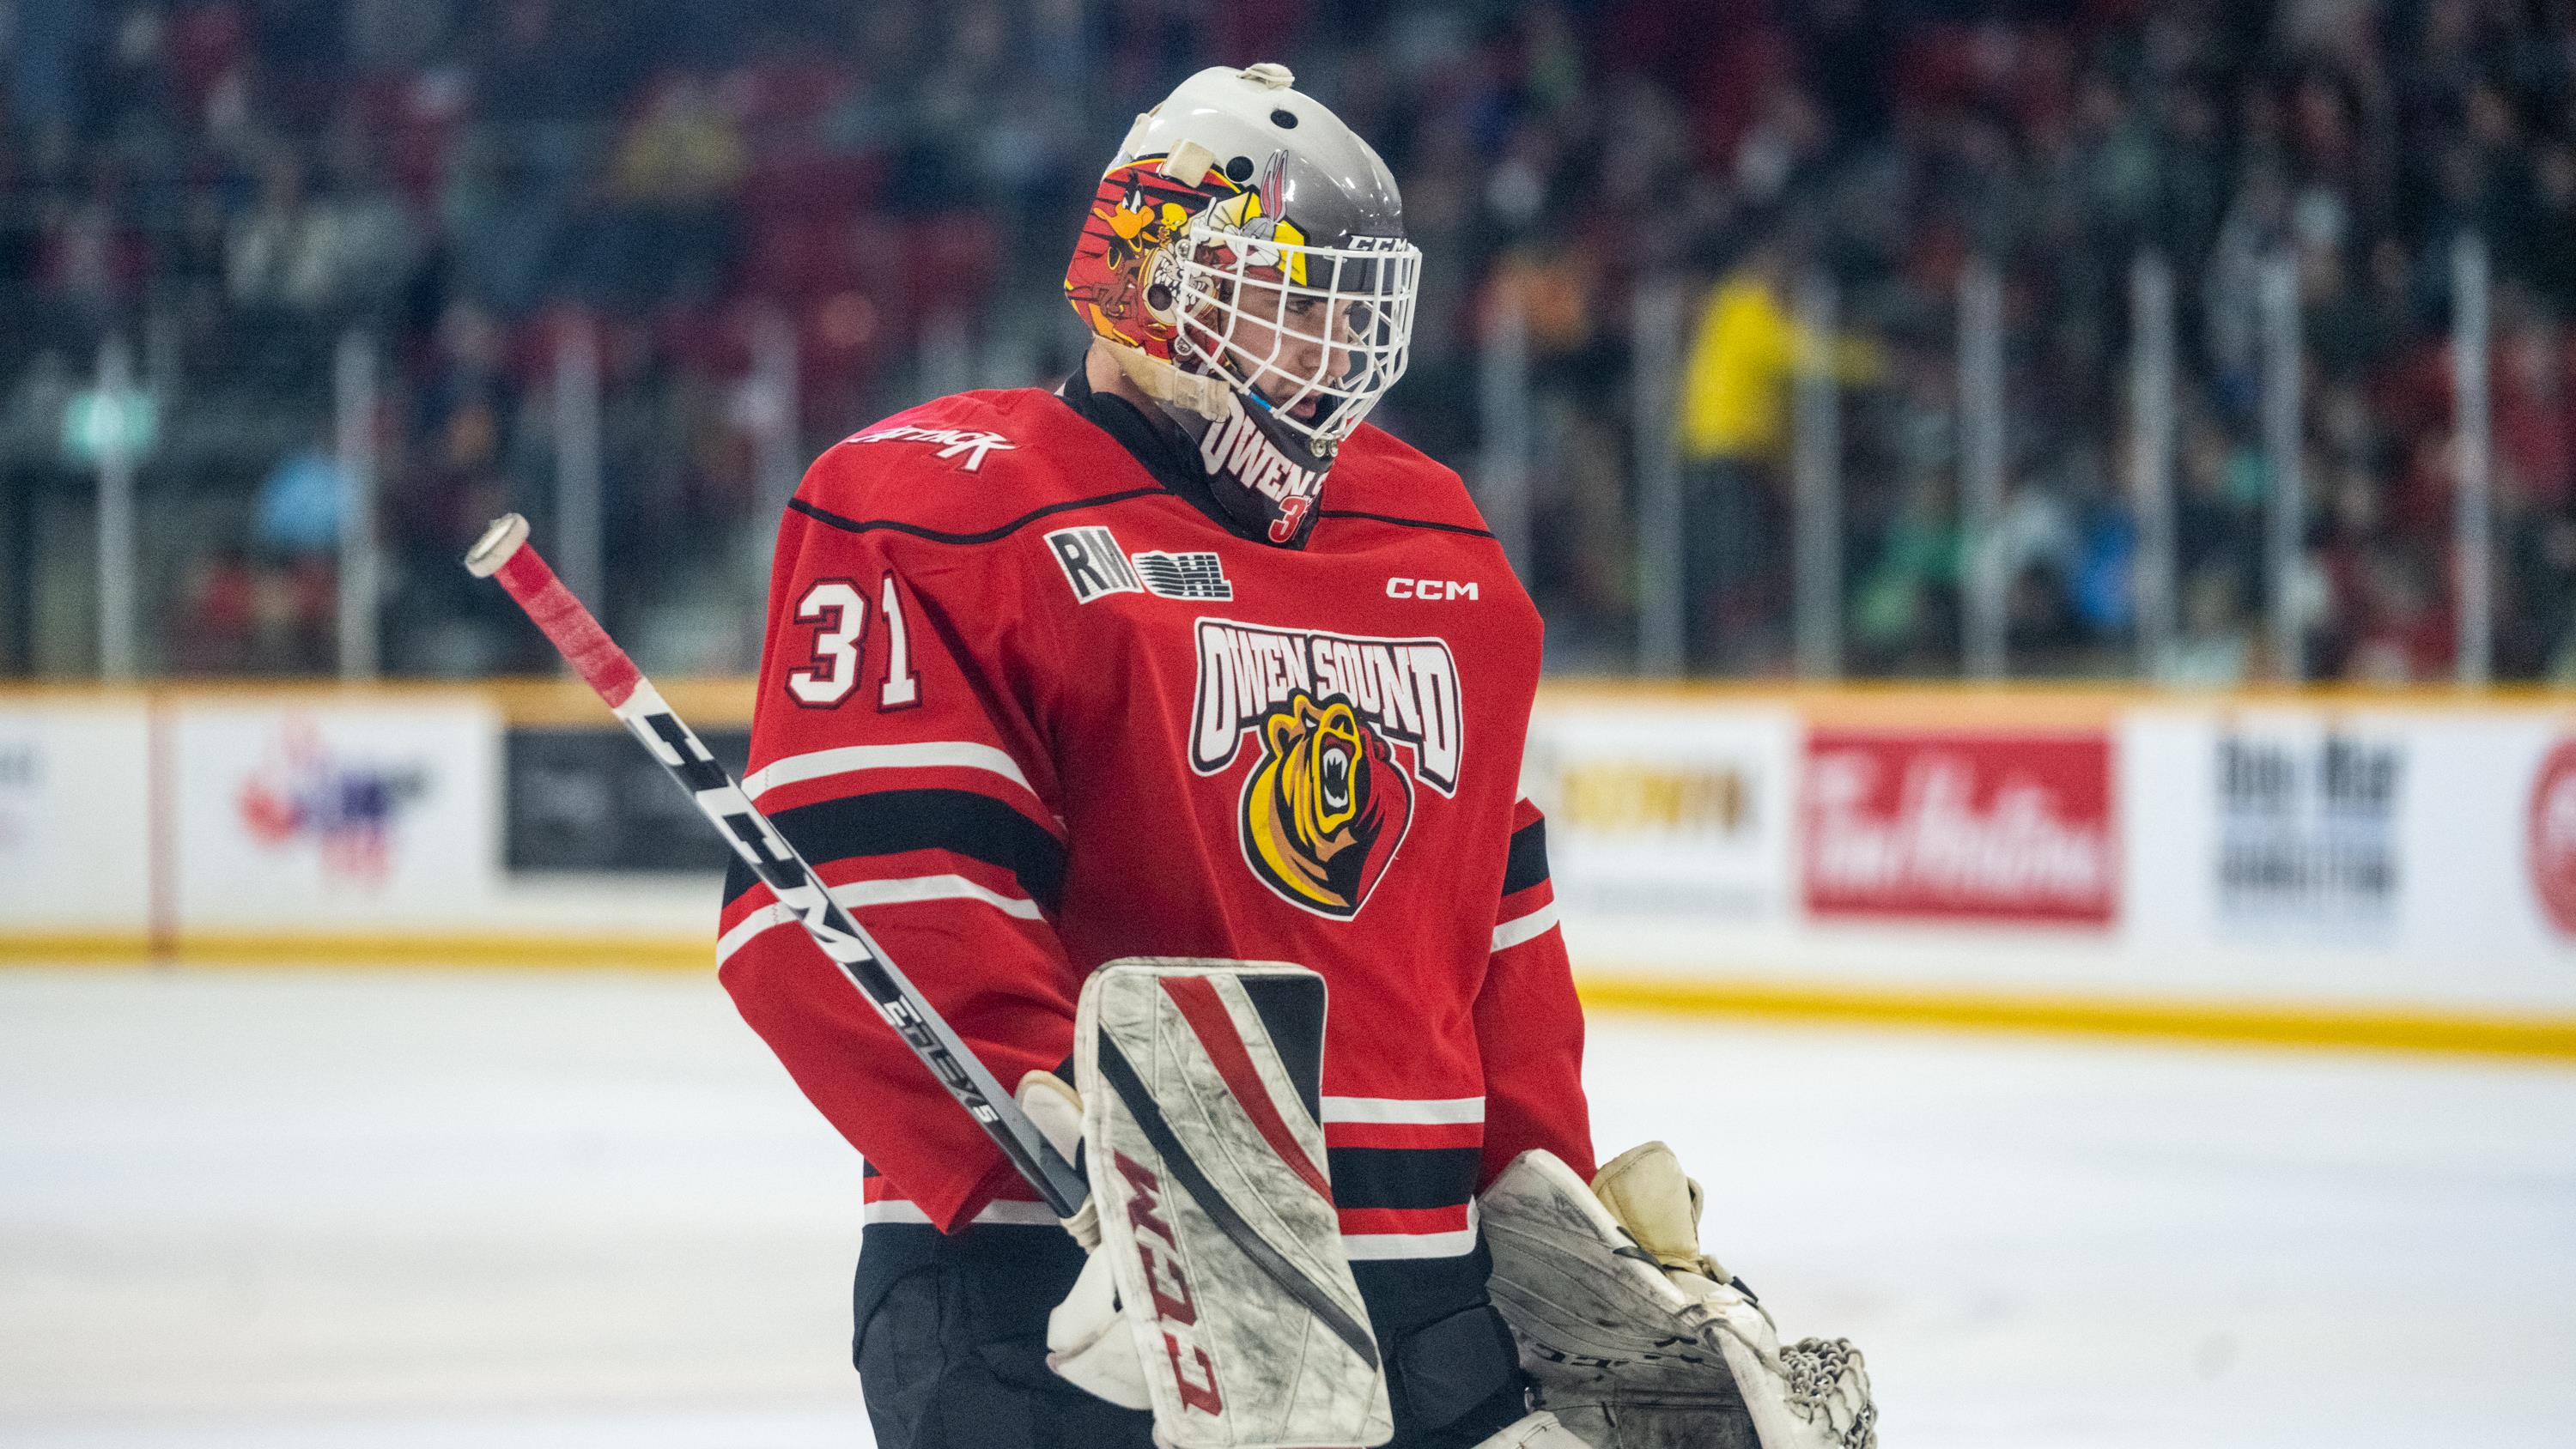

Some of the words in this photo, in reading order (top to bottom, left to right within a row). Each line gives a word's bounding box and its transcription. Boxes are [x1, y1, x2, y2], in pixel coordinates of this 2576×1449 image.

[1347, 234, 1408, 252] CCM
[1200, 391, 1316, 503] OWEN
[1267, 494, 1313, 543] 3
[1050, 530, 1140, 599] RM
[1135, 553, 1232, 599] OHL
[1385, 576, 1479, 601] CCM
[785, 570, 921, 712] 31
[1198, 623, 1312, 764] OWEN
[1311, 638, 1457, 785] SOUND
[617, 691, 874, 965] CCM
[1112, 1145, 1224, 1417] CCM
